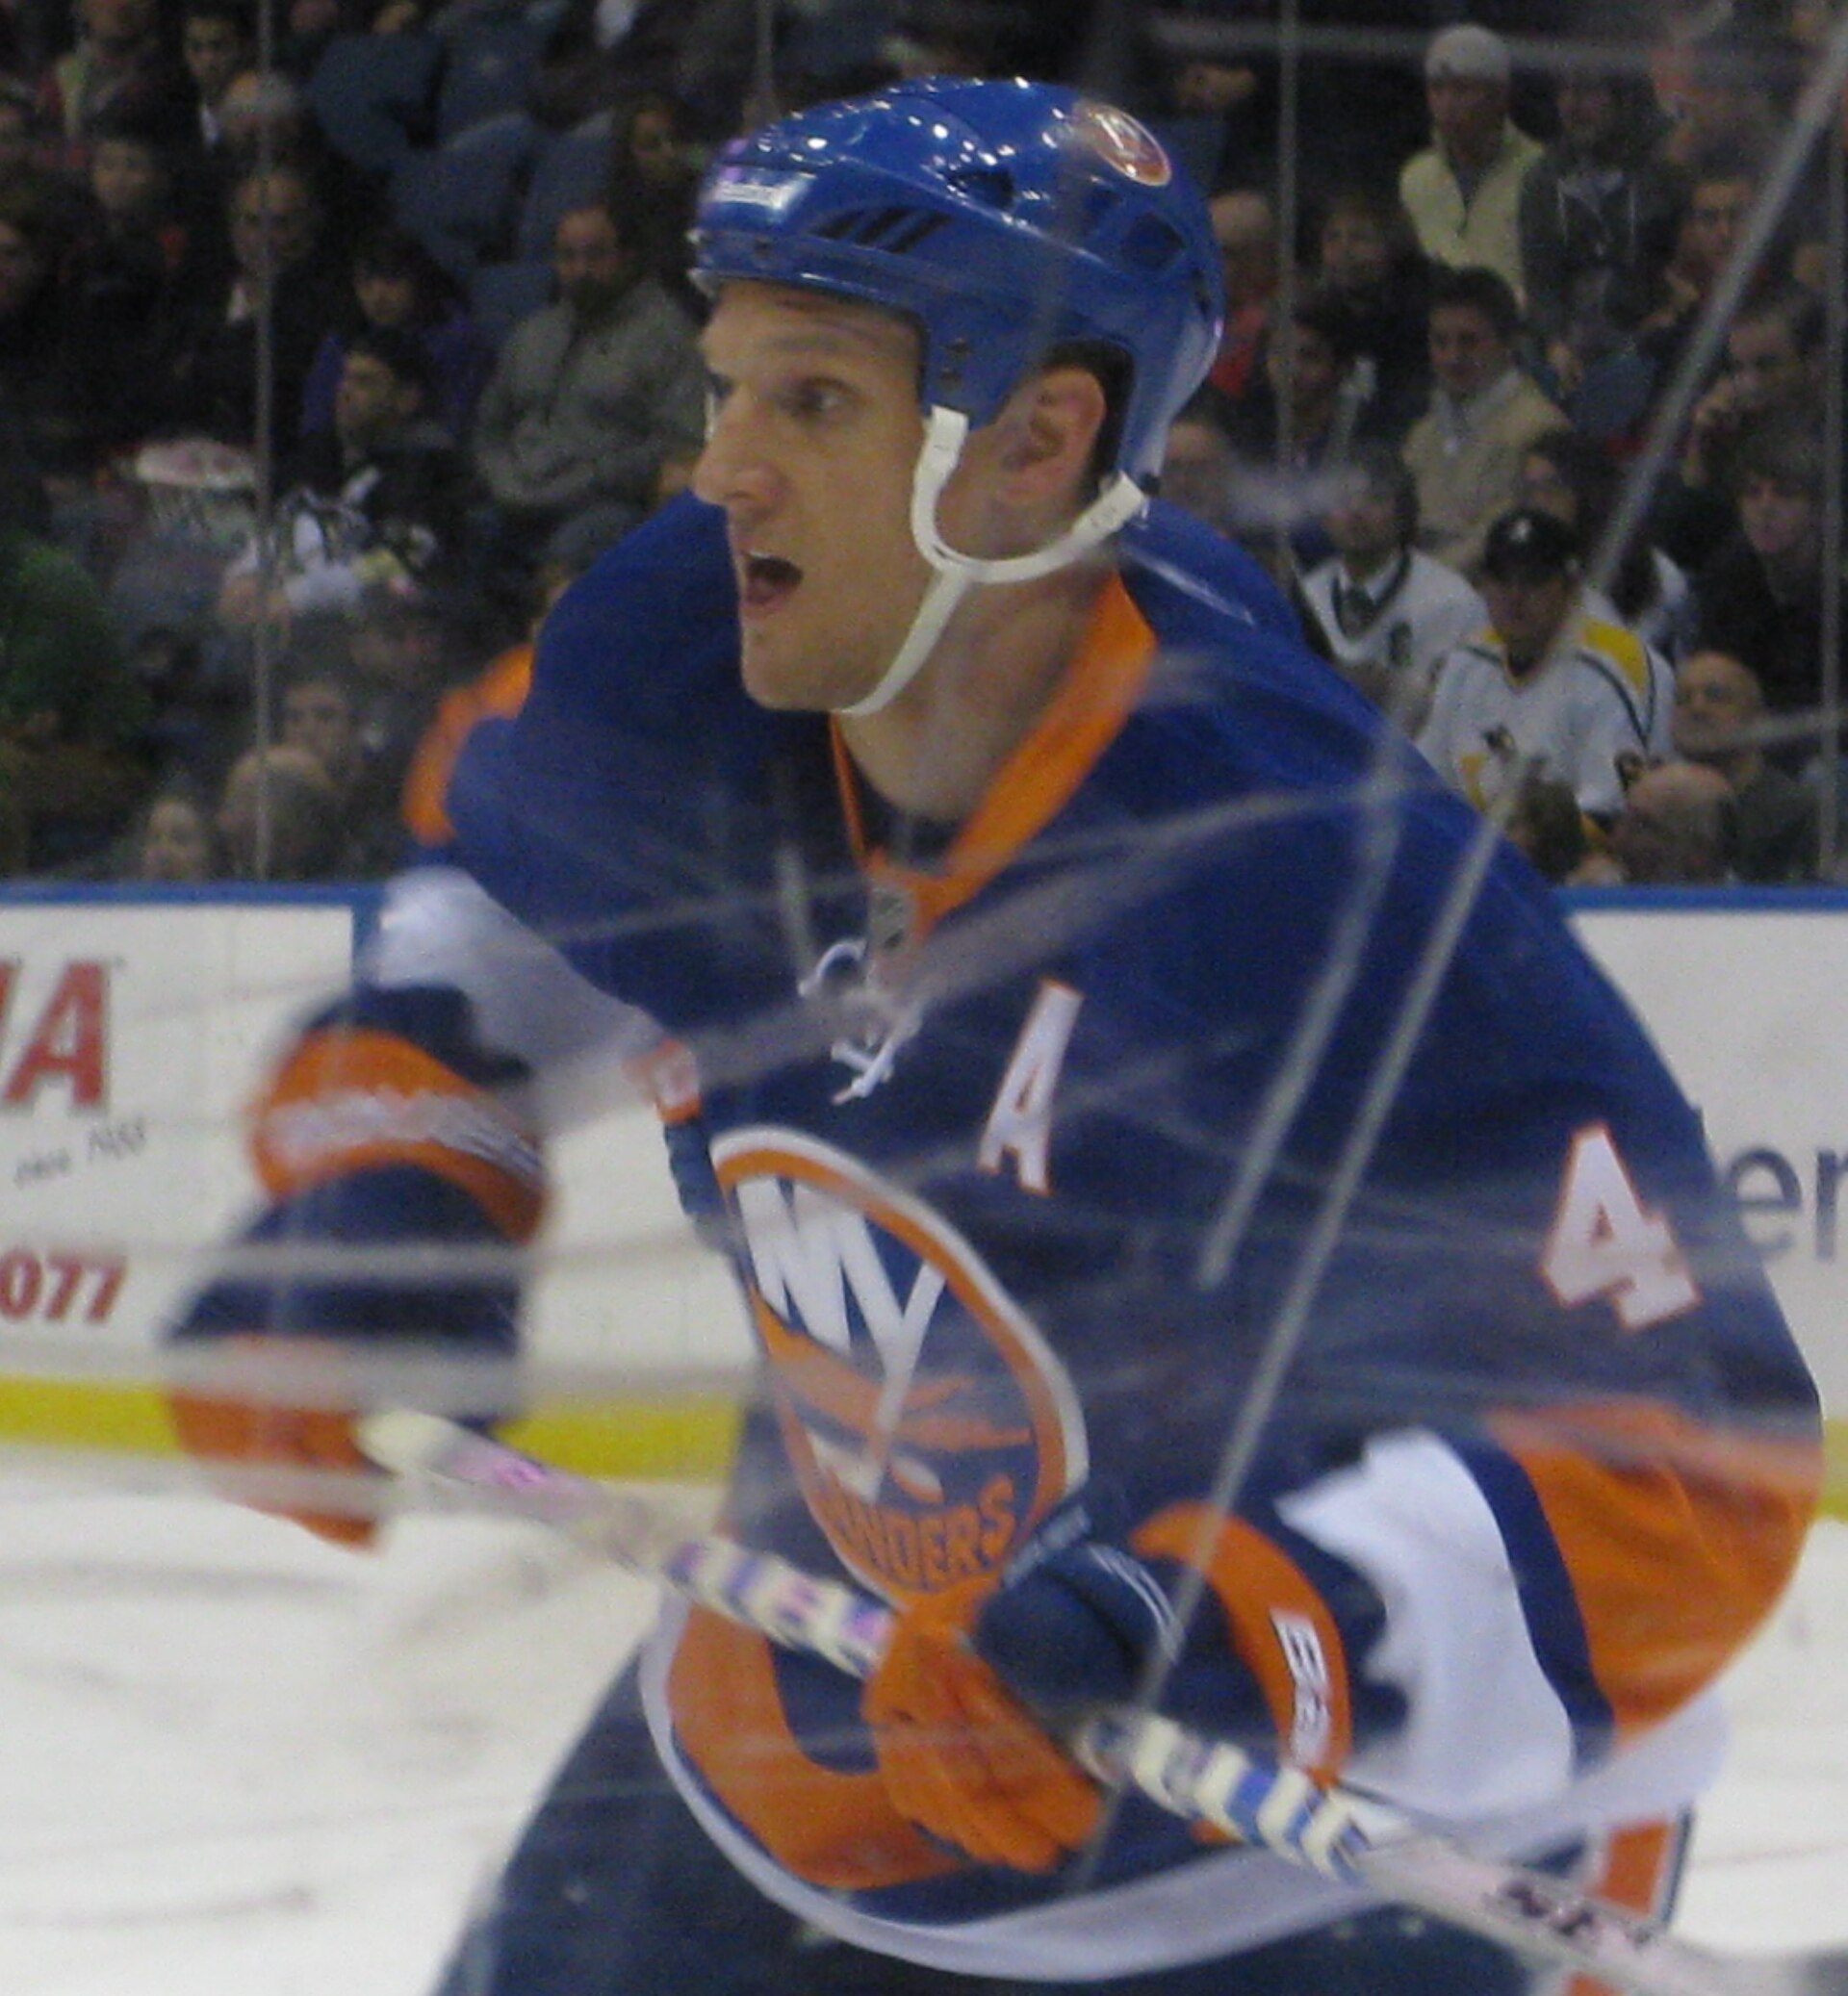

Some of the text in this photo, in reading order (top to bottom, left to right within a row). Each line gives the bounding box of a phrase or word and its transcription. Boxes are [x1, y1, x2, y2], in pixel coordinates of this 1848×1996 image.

[977, 978, 1083, 1195] A
[0, 1251, 127, 1322] 077
[1539, 1121, 1702, 1330] 4
